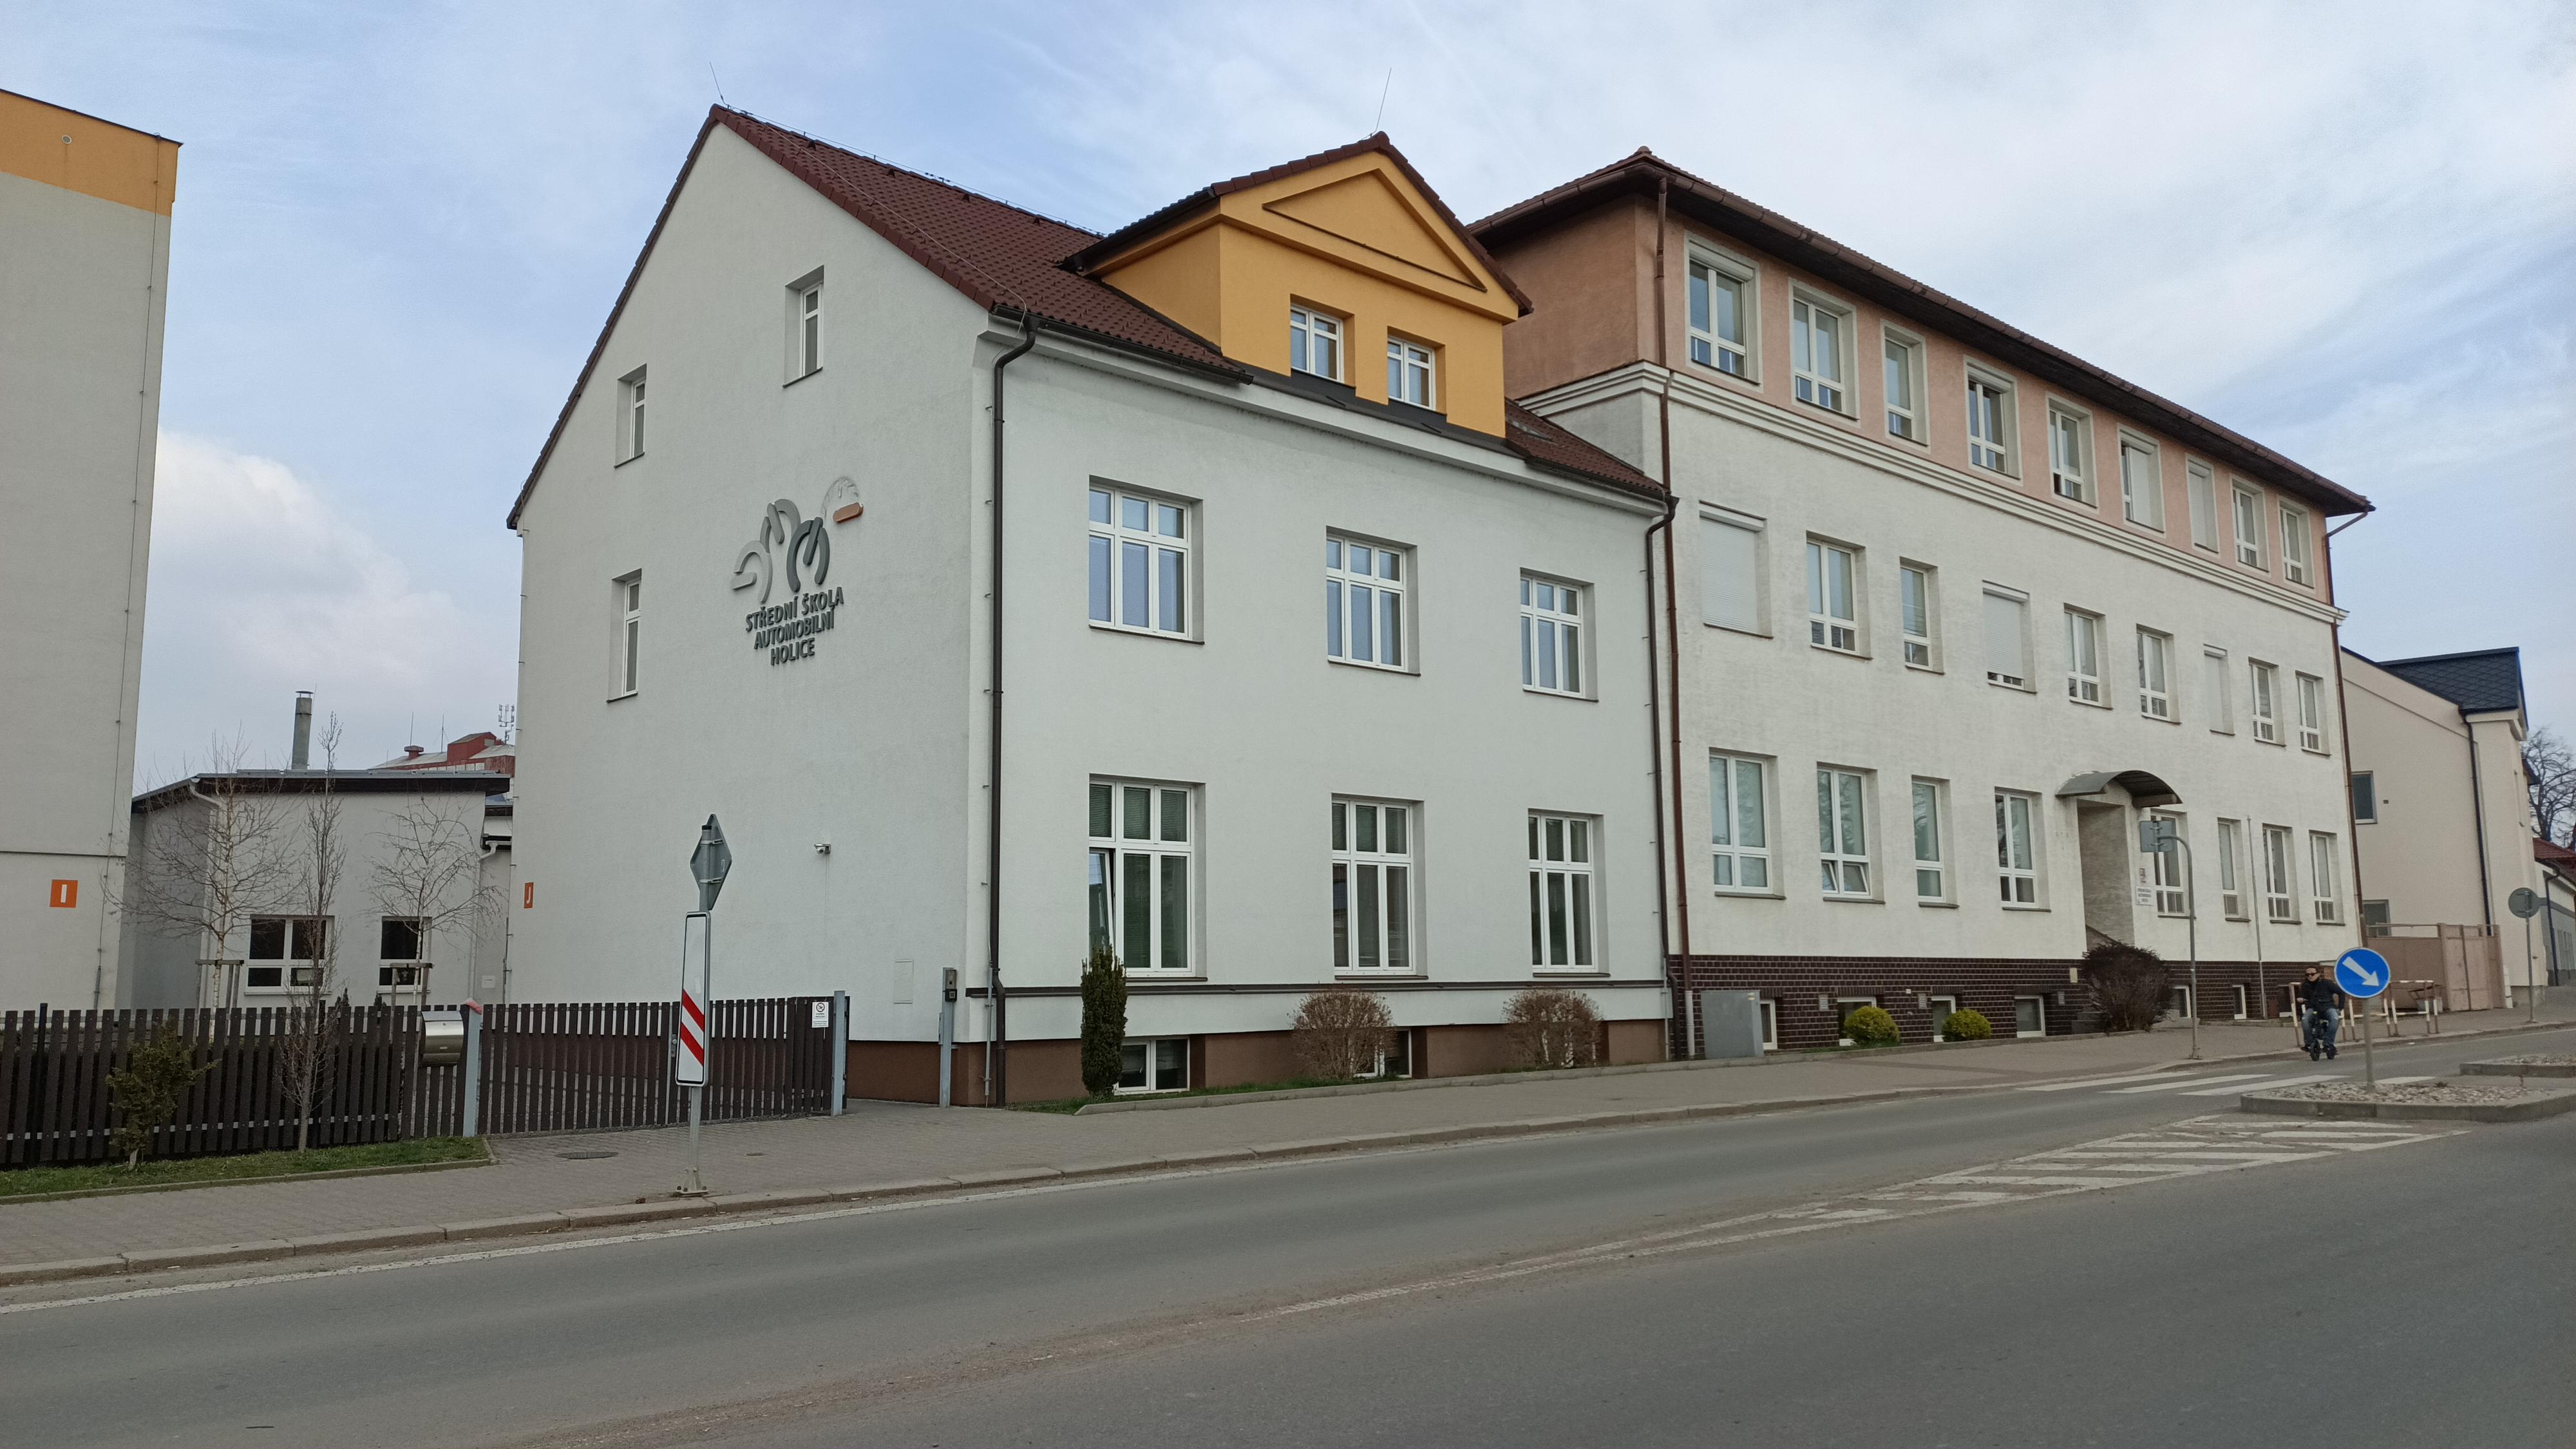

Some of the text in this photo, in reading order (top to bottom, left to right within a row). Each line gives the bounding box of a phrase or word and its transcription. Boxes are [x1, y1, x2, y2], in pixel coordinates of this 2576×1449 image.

[745, 586, 844, 633] STŘEDNÍ ŠKOLA
[753, 605, 835, 650] AUTOMOBILNÍ
[770, 637, 815, 666] HOLICE
[526, 886, 531, 904] J
